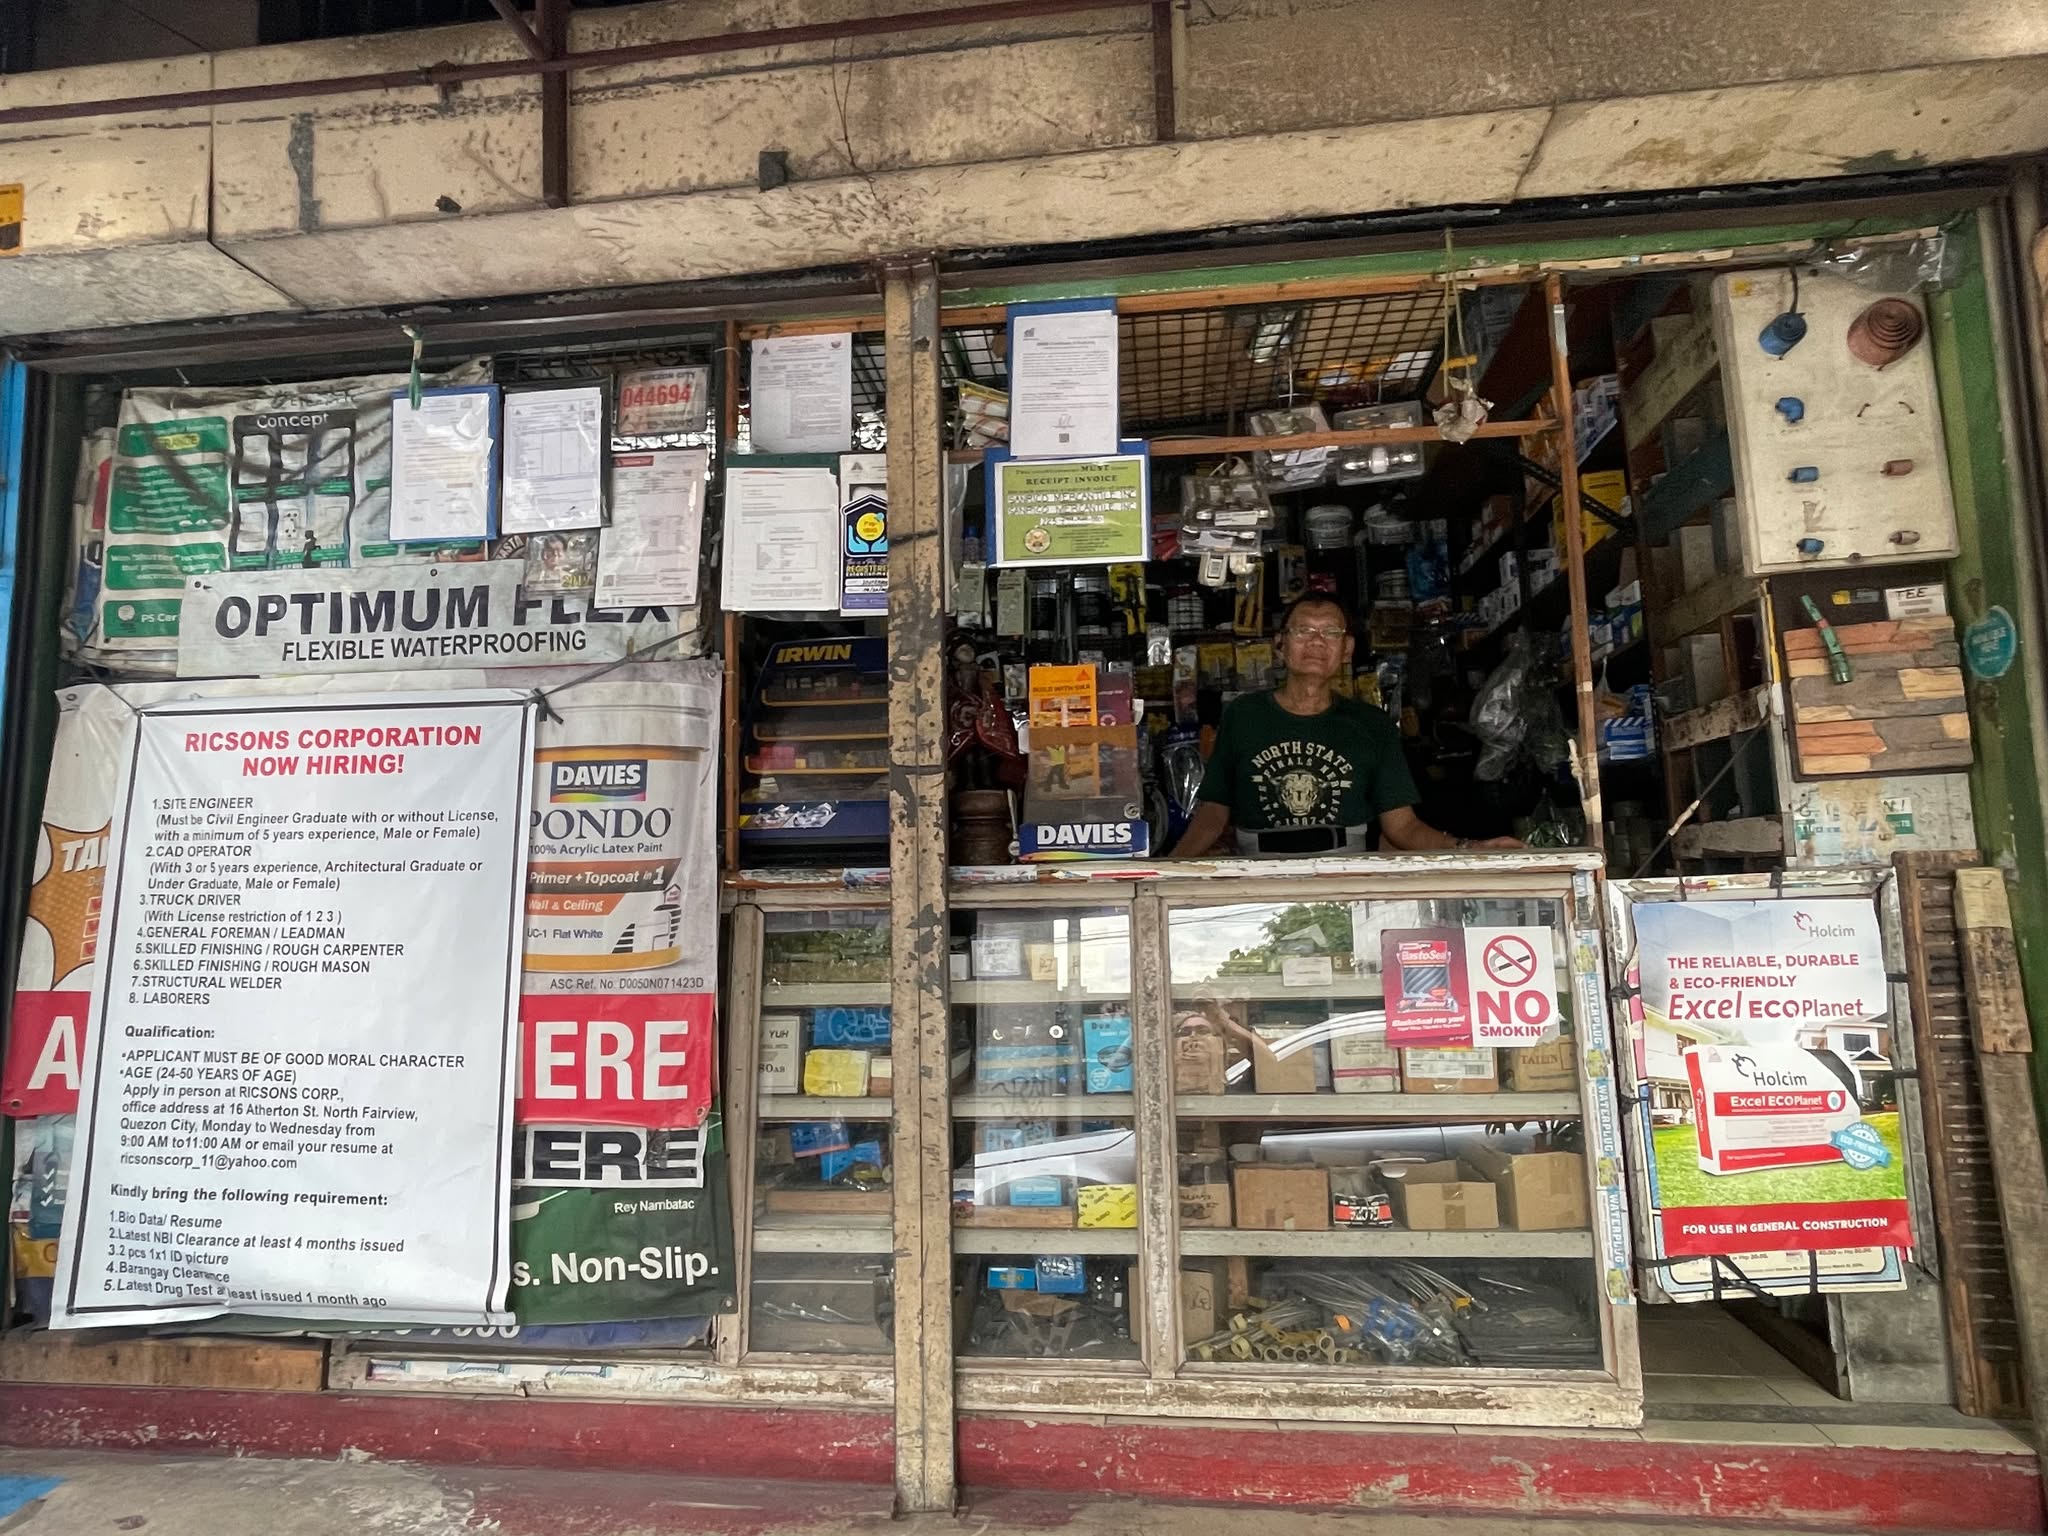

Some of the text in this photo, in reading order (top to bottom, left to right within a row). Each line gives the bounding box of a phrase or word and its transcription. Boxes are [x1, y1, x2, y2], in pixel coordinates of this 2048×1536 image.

[622, 383, 692, 409] 044694
[256, 412, 329, 430] Concept
[215, 584, 490, 638] OPTIMUM
[281, 629, 586, 661] FLEXIBLE WATERPROOFING
[776, 644, 852, 664] IRWIN
[185, 725, 481, 752] RICSONS CORPORATION
[242, 753, 404, 776] NOW HIRING!
[1251, 740, 1353, 775] NORTH STATE
[556, 764, 640, 785] DAVIES
[152, 797, 253, 809] 1.SITE ENGINEER
[1037, 823, 1132, 845] DAVIES
[61, 838, 110, 873] TA
[144, 845, 252, 857] 2.CAD OPERATOR
[559, 843, 599, 856] Acrylic
[601, 842, 634, 853] Latex
[637, 842, 662, 853] Paint
[530, 871, 572, 884] Primer
[584, 870, 639, 886] Topcoat
[139, 893, 241, 906] 3.TRUCK DRIVER
[551, 901, 559, 910] &
[563, 899, 604, 912] Ceiling
[136, 926, 345, 939] 4.GENERAL FOREMAN / LEADMAN
[552, 928, 571, 939] Flat
[572, 928, 603, 938] White
[1808, 924, 1855, 938] Holcim
[135, 942, 404, 956] 5.SKILLED FINISHING / ROUGH CARPENTER
[133, 959, 370, 973] 6.SKILLED FINISHING / ROUGH MASON
[1666, 953, 1859, 969] THE RELIABLE, DURABLE
[131, 975, 282, 990] 7.STRUCTURAL WELDER
[549, 978, 574, 989] ASC
[1669, 975, 1796, 989] & ECO-FRIENDLY
[128, 991, 210, 1005] 8. LABORERS
[1476, 989, 1551, 1025] NO
[1668, 991, 1865, 1020] Excel ECOPlanet
[125, 1025, 214, 1038] Qualification:
[126, 1049, 464, 1068] APPLICANT MUST BE OF GOOD MORAL CHARACTER
[517, 1020, 689, 1101] ERE
[124, 1066, 296, 1085] AGE (24-50 YEARS OF AGE)
[1752, 1070, 1807, 1086] Holcim
[122, 1083, 343, 1102] Apply in person at RICSONS CORP.,
[1730, 1095, 1822, 1107] Excel ECOPlanet
[120, 1117, 375, 1139] Quezon City, Monday to Wednesday from
[512, 1129, 699, 1181] ERE
[110, 1183, 387, 1206] Kindly bring the following requirement:
[614, 1198, 694, 1214] Rey Nambatac
[109, 1210, 222, 1228] 1.Bio Data/ Resume
[1682, 1217, 1887, 1234] FOR USE IN GENERAL CONSTRUCTION
[551, 1245, 719, 1285] Non-Slip.
